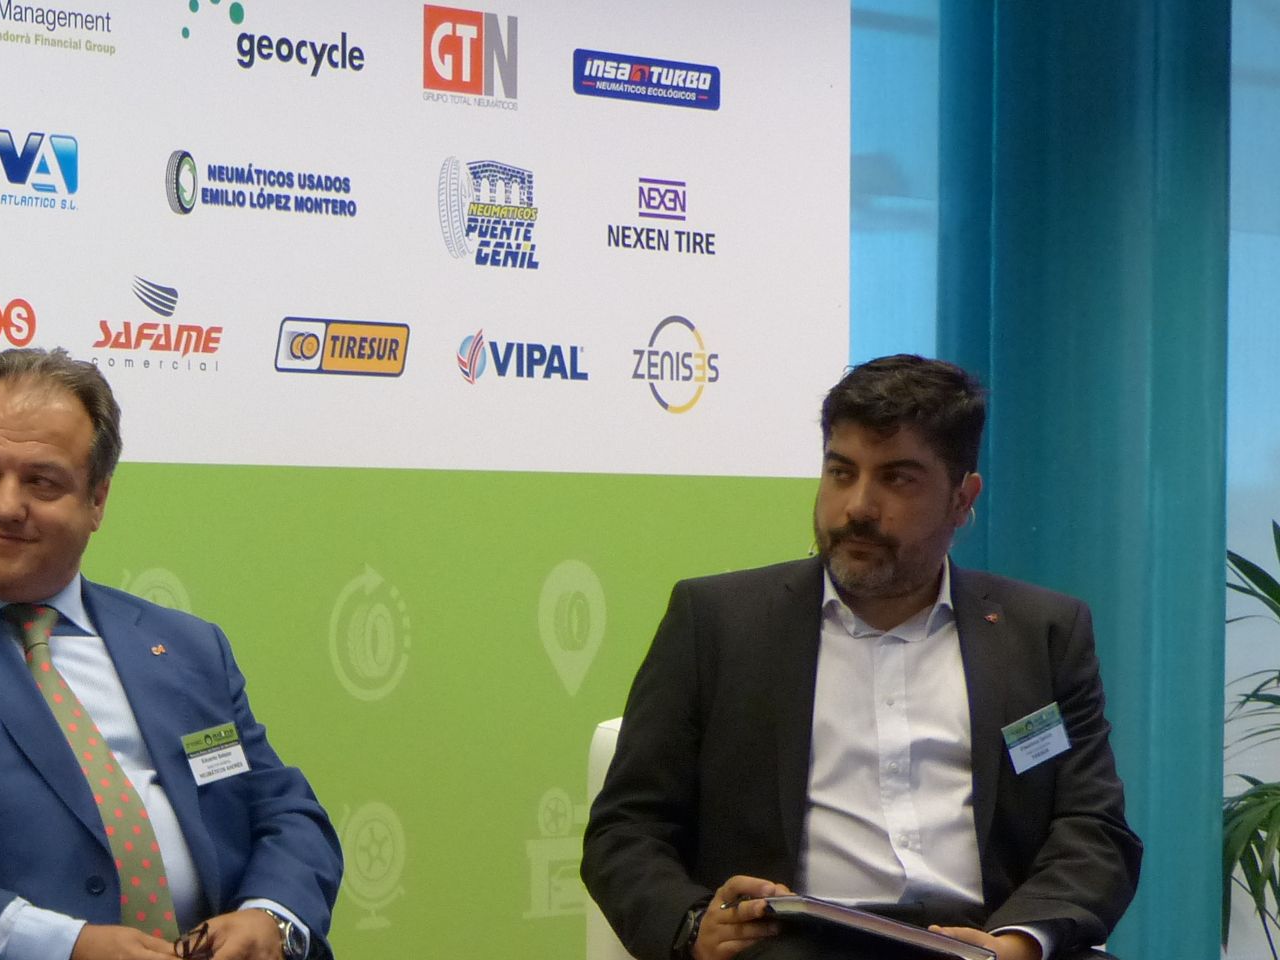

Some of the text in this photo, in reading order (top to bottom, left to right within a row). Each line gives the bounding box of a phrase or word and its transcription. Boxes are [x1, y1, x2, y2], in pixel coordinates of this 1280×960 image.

[34, 34, 82, 50] Financial
[85, 40, 117, 55] Group
[236, 32, 365, 77] geocycle
[429, 13, 518, 100] GTN
[422, 91, 448, 103] GRUPO
[450, 95, 471, 106] TOTAL
[596, 80, 697, 101] NEUMÁTICOS ECOLÓGICOS
[207, 163, 351, 193] NEUMÁTICOS USADOS
[0, 194, 56, 209] ATLANTICO
[201, 187, 357, 217] EMILIO LÓPEZ MONTERO
[465, 217, 535, 242] PUENTE
[607, 224, 716, 255] NEXEN TIRE
[92, 319, 224, 358] SAFAME
[330, 335, 400, 361] TIRESUR
[92, 356, 219, 372] comercial
[488, 341, 589, 381] VIPAL
